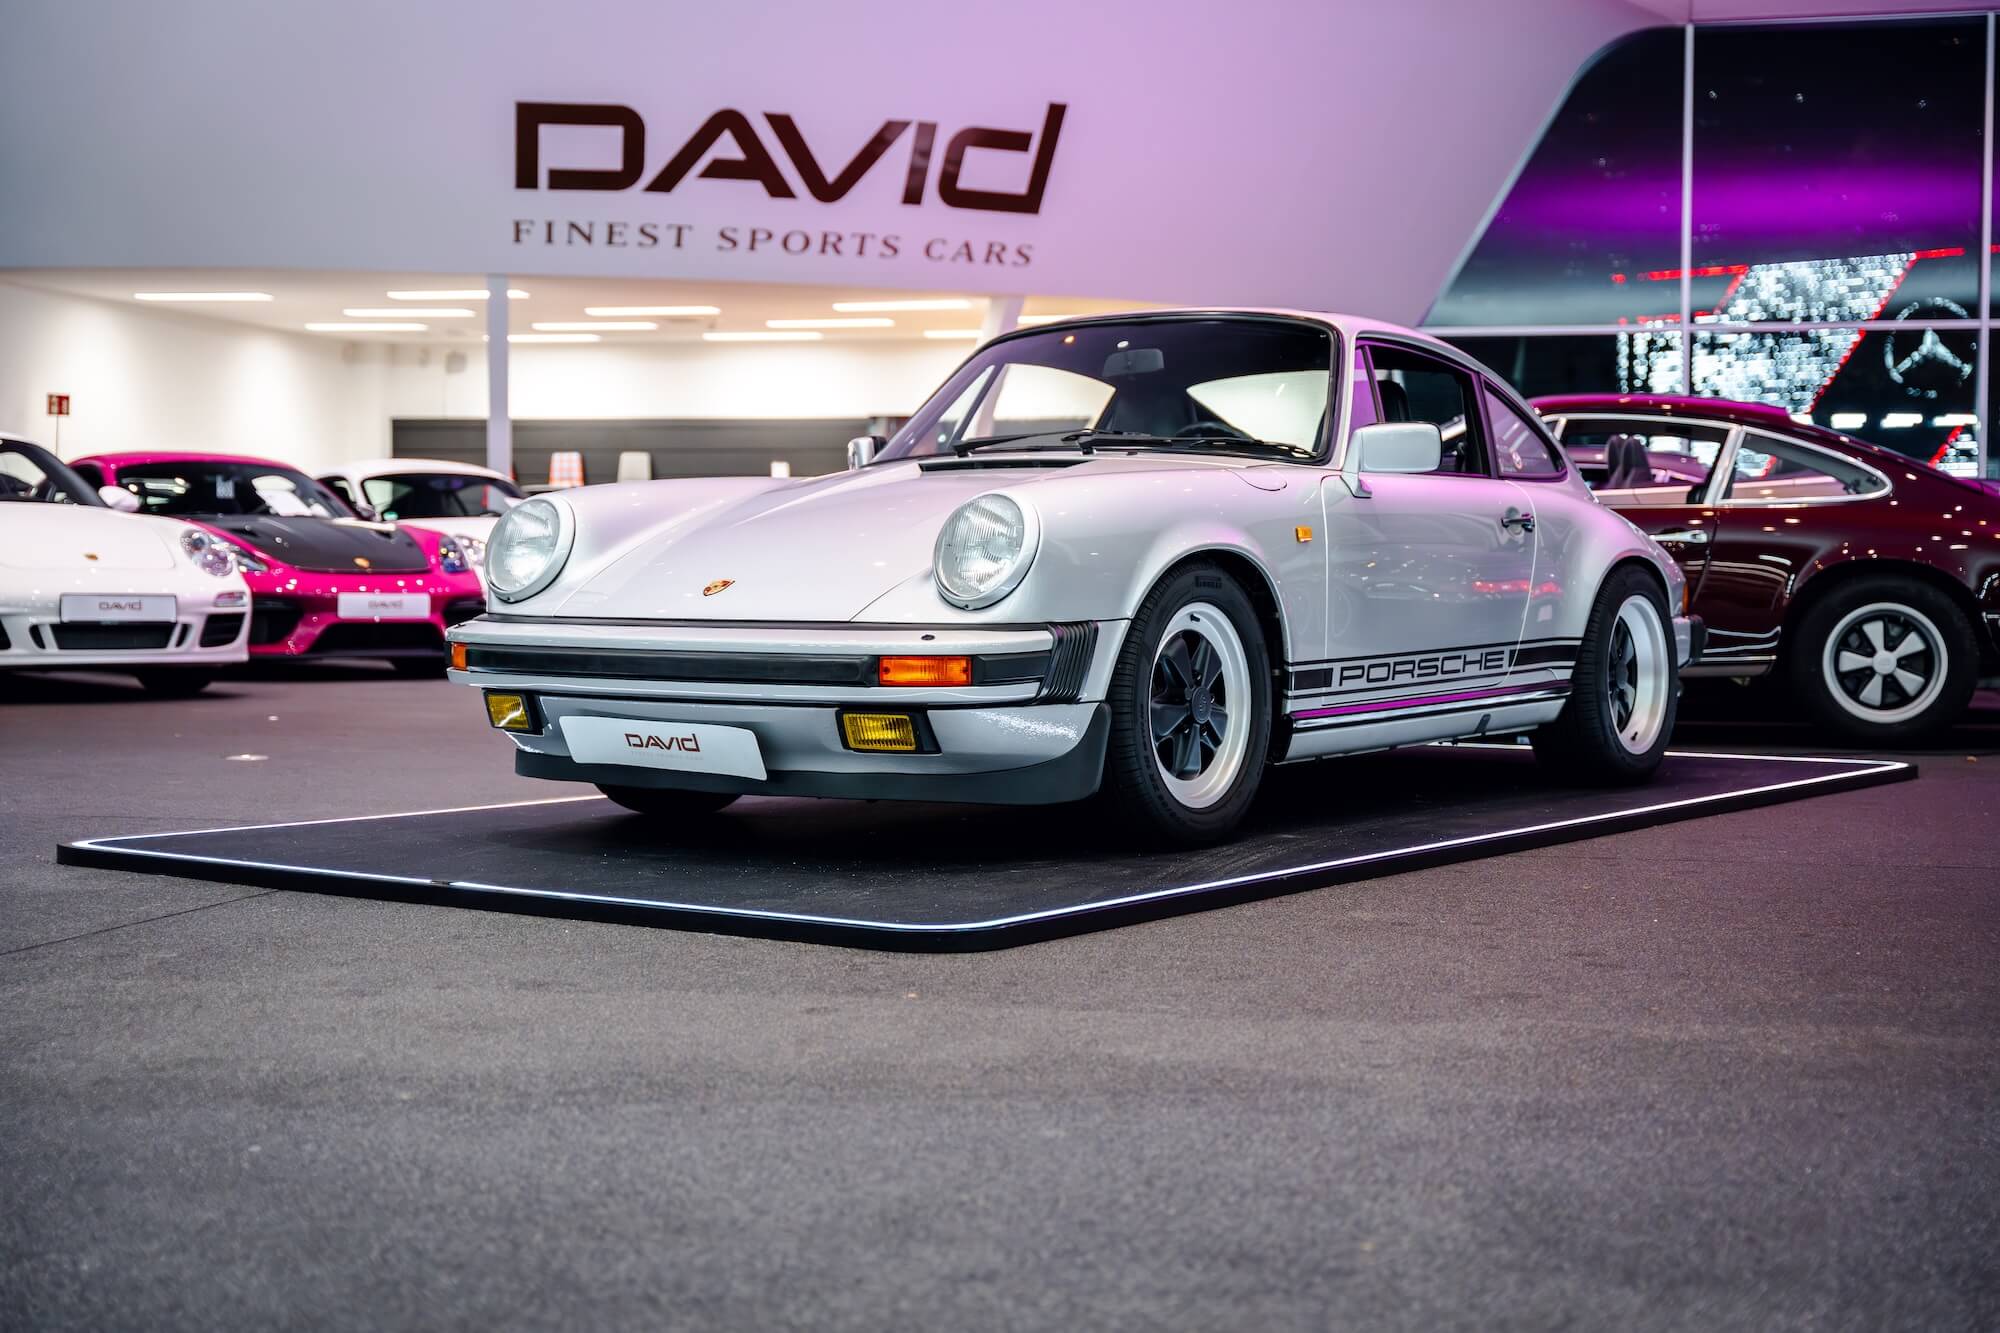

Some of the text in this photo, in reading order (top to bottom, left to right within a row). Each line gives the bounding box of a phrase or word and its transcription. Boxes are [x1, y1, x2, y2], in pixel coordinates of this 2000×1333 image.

[512, 219, 1034, 267] FINEST SPORTS CARS
[1339, 650, 1505, 687] PORSCHE
